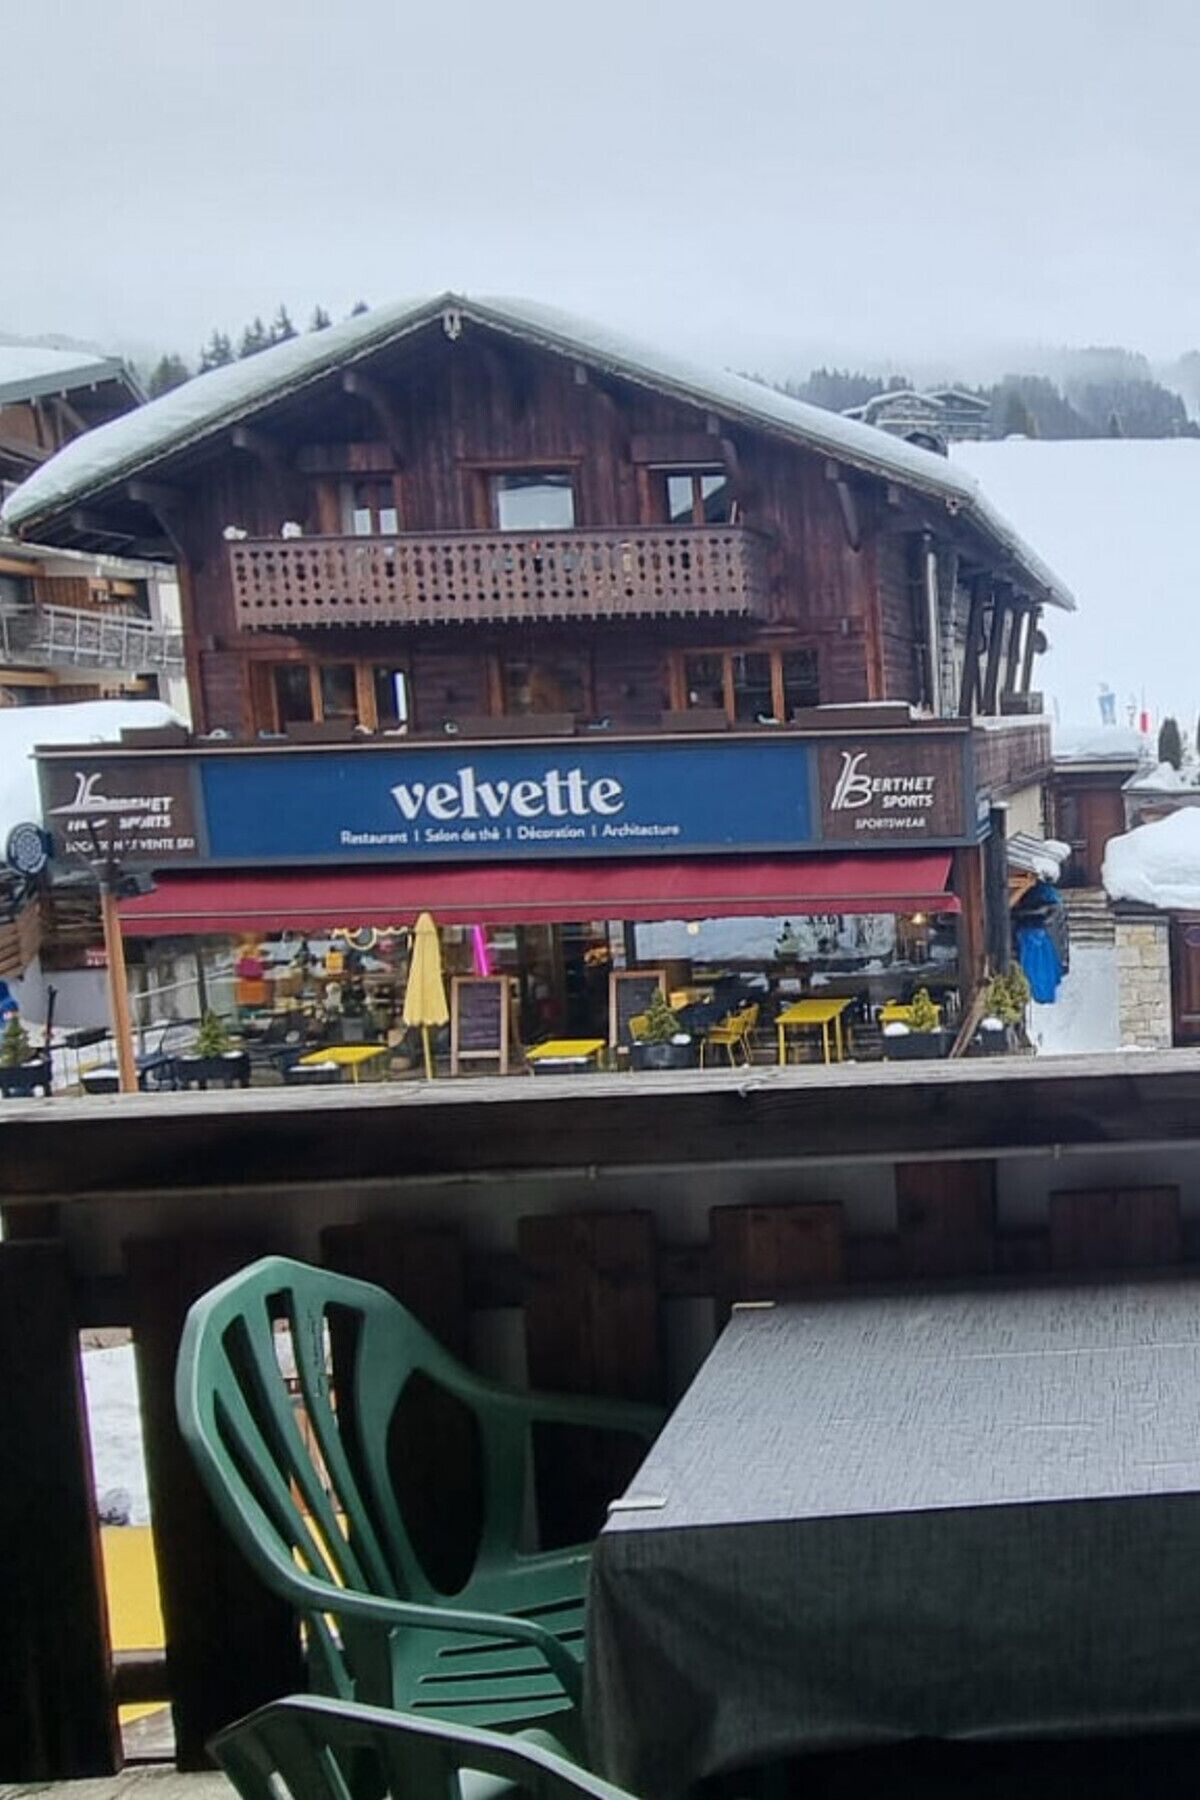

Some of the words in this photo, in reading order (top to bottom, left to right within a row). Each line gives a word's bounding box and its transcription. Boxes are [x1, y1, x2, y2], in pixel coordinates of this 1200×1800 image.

[831, 752, 935, 810] BERTHET
[390, 766, 625, 820] velvette
[883, 794, 934, 809] SPORTS
[340, 830, 408, 845] Restaurant
[424, 828, 460, 842] Salon
[460, 828, 477, 842] de
[517, 823, 585, 840] Décoration
[602, 822, 680, 837] Architecture
[854, 817, 927, 830] SPORTSWEAR
